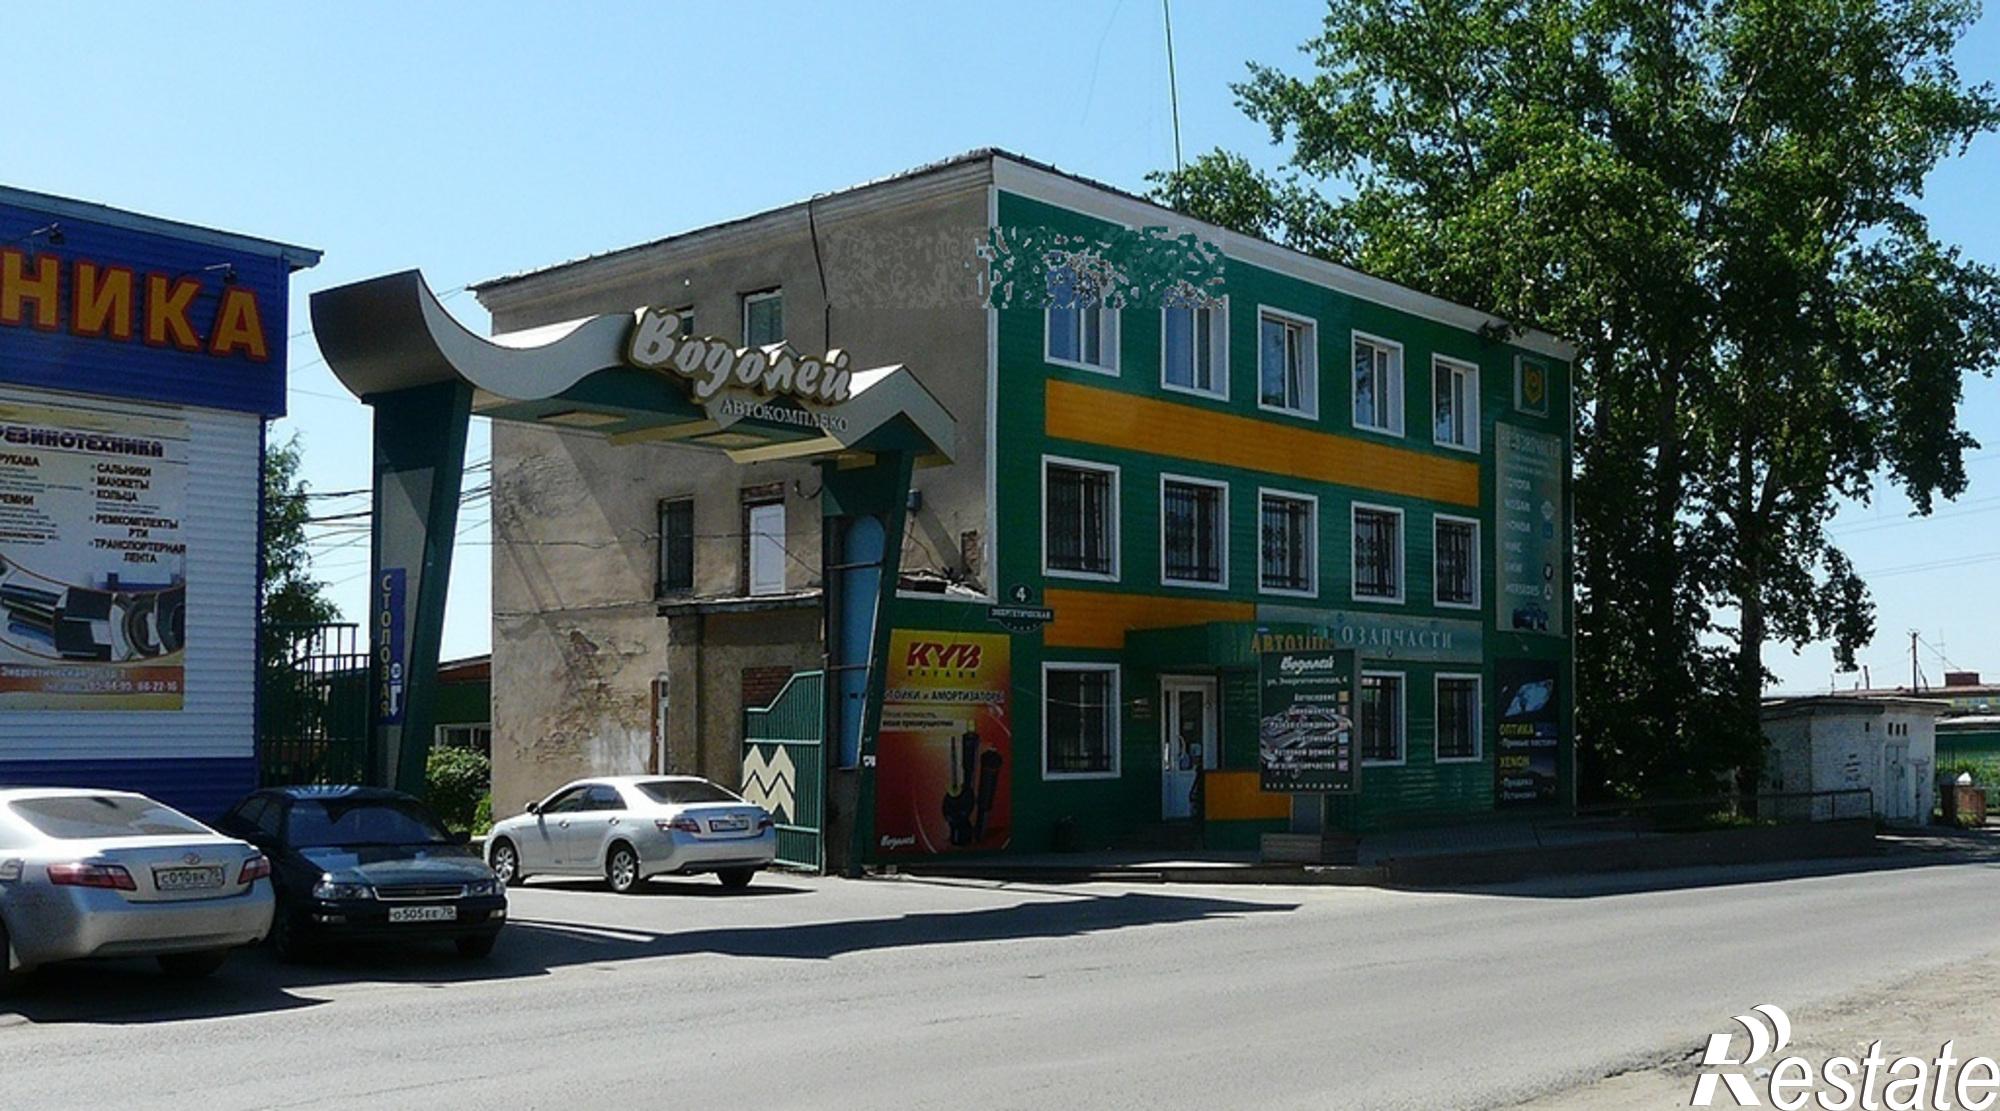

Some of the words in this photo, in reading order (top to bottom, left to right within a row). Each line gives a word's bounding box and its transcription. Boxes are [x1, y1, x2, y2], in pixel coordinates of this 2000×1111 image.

[0, 249, 268, 362] НИКА
[630, 307, 852, 404] Водолей
[97, 463, 151, 477] САЛЬНИКИ
[97, 476, 149, 489] МАНЖЕТЫ
[97, 490, 138, 502] КОЛЬЦА
[96, 514, 179, 529] РЕМКОМПЛЕКТЫ
[128, 528, 148, 538] РТИ
[94, 538, 186, 554] ТРАНСПОРТЕРНАЯ
[123, 552, 157, 564] ЛЕНТА
[1016, 587, 1026, 603] 4
[380, 575, 392, 718] СТОЛОВАЯ
[906, 641, 983, 670] KYB
[1280, 655, 1335, 675] Водолей
[1498, 722, 1535, 737] ОПТИКА
